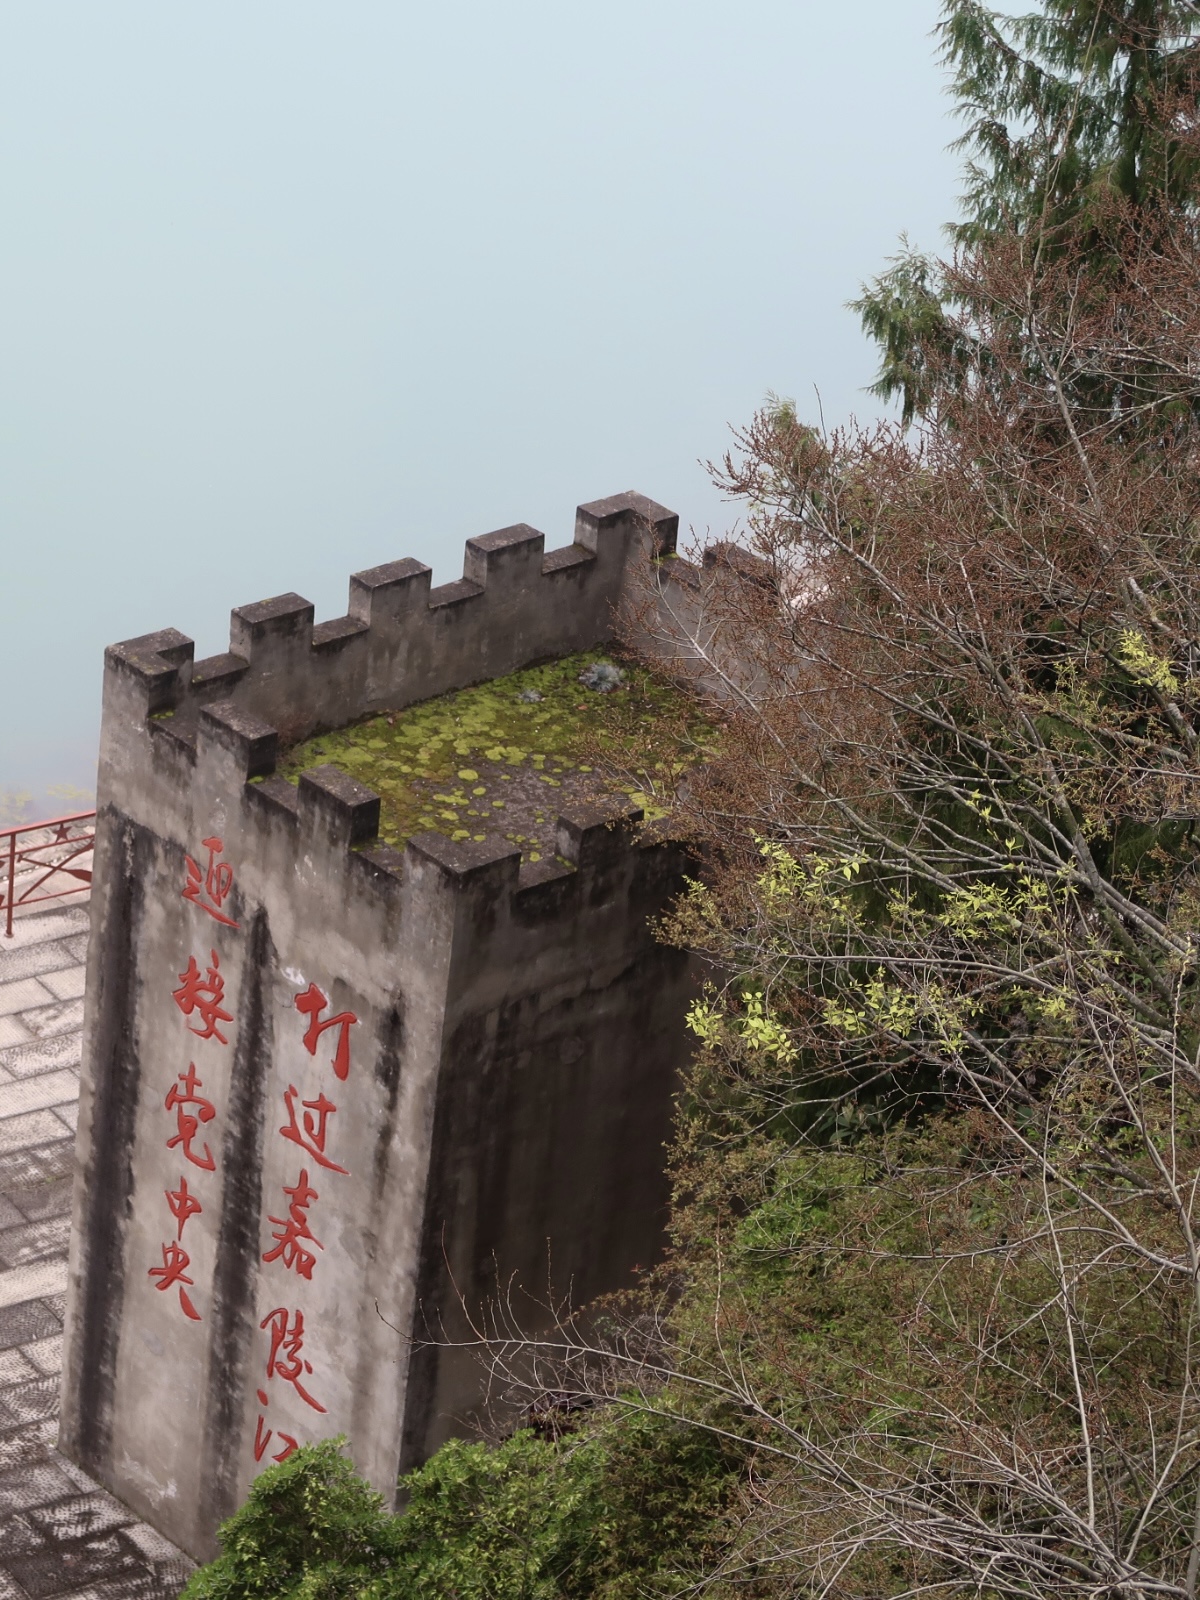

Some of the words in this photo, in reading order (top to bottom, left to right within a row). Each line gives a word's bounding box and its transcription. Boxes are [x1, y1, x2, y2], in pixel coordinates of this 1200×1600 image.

[148, 836, 240, 1321] 迎接党中央
